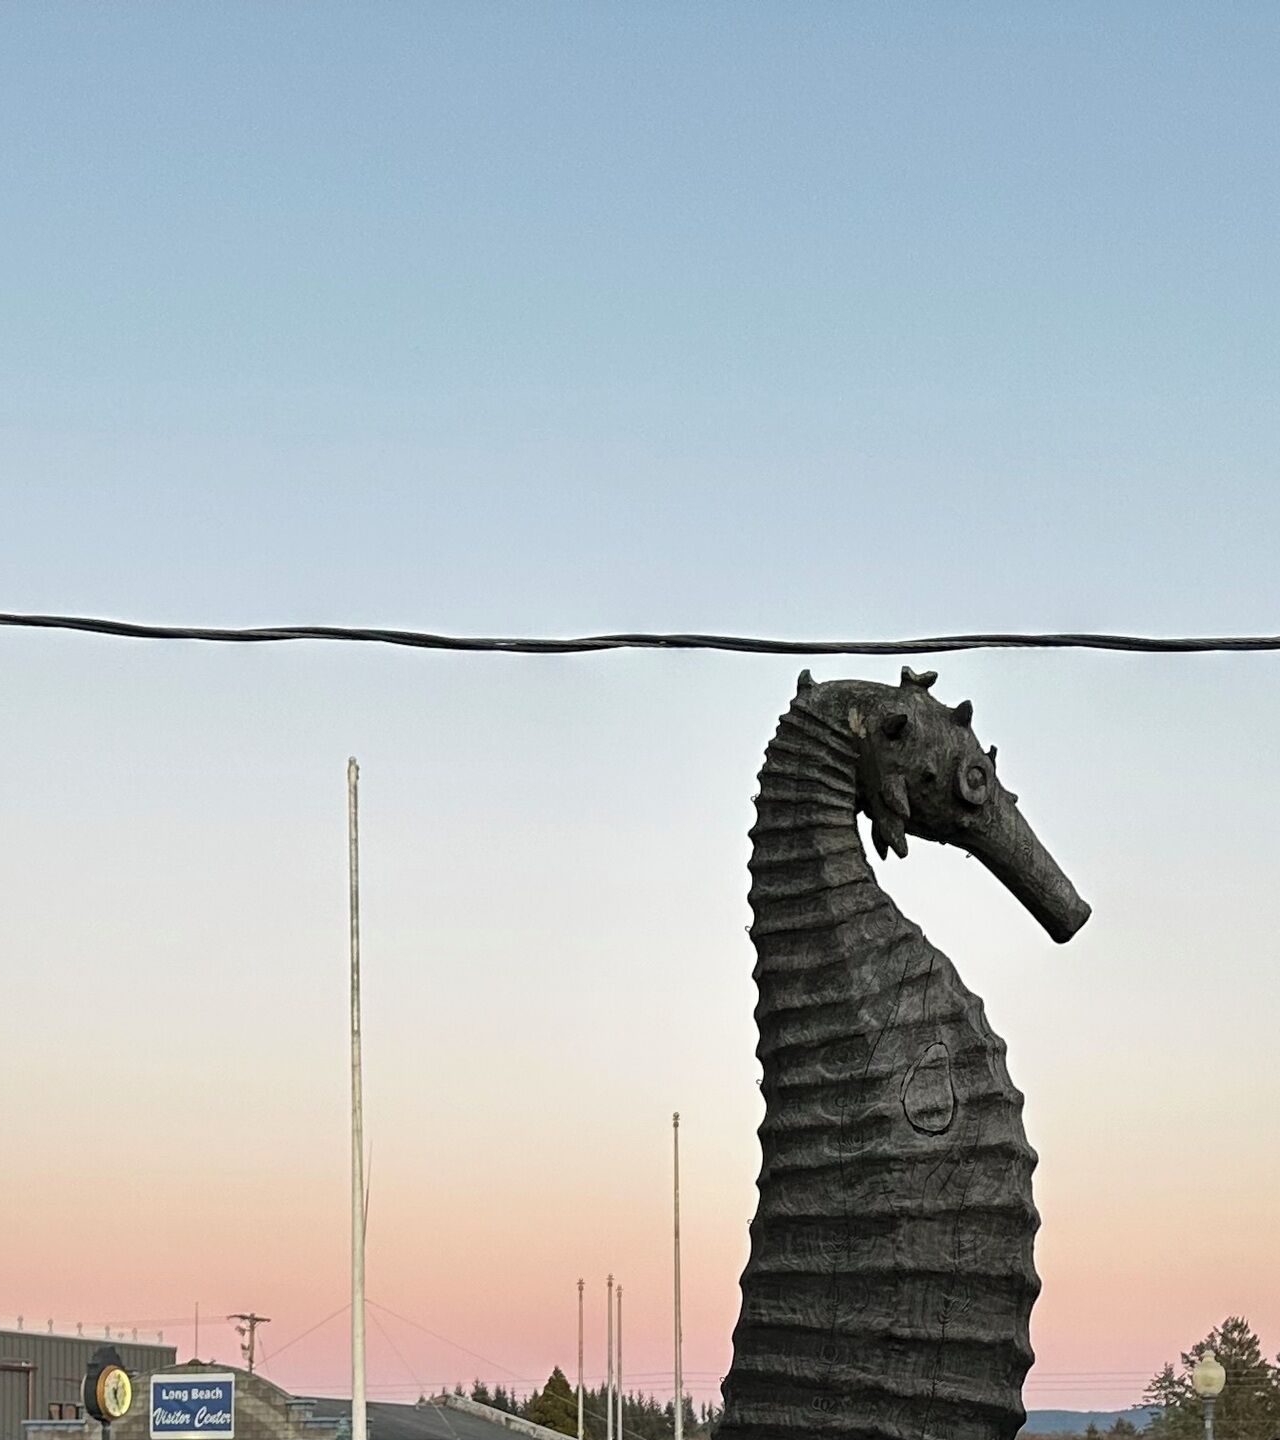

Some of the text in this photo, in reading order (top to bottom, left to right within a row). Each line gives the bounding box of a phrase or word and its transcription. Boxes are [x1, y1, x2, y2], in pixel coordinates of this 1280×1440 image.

[161, 1387, 223, 1402] Long Beach
[152, 1406, 232, 1428] Visitor Center
